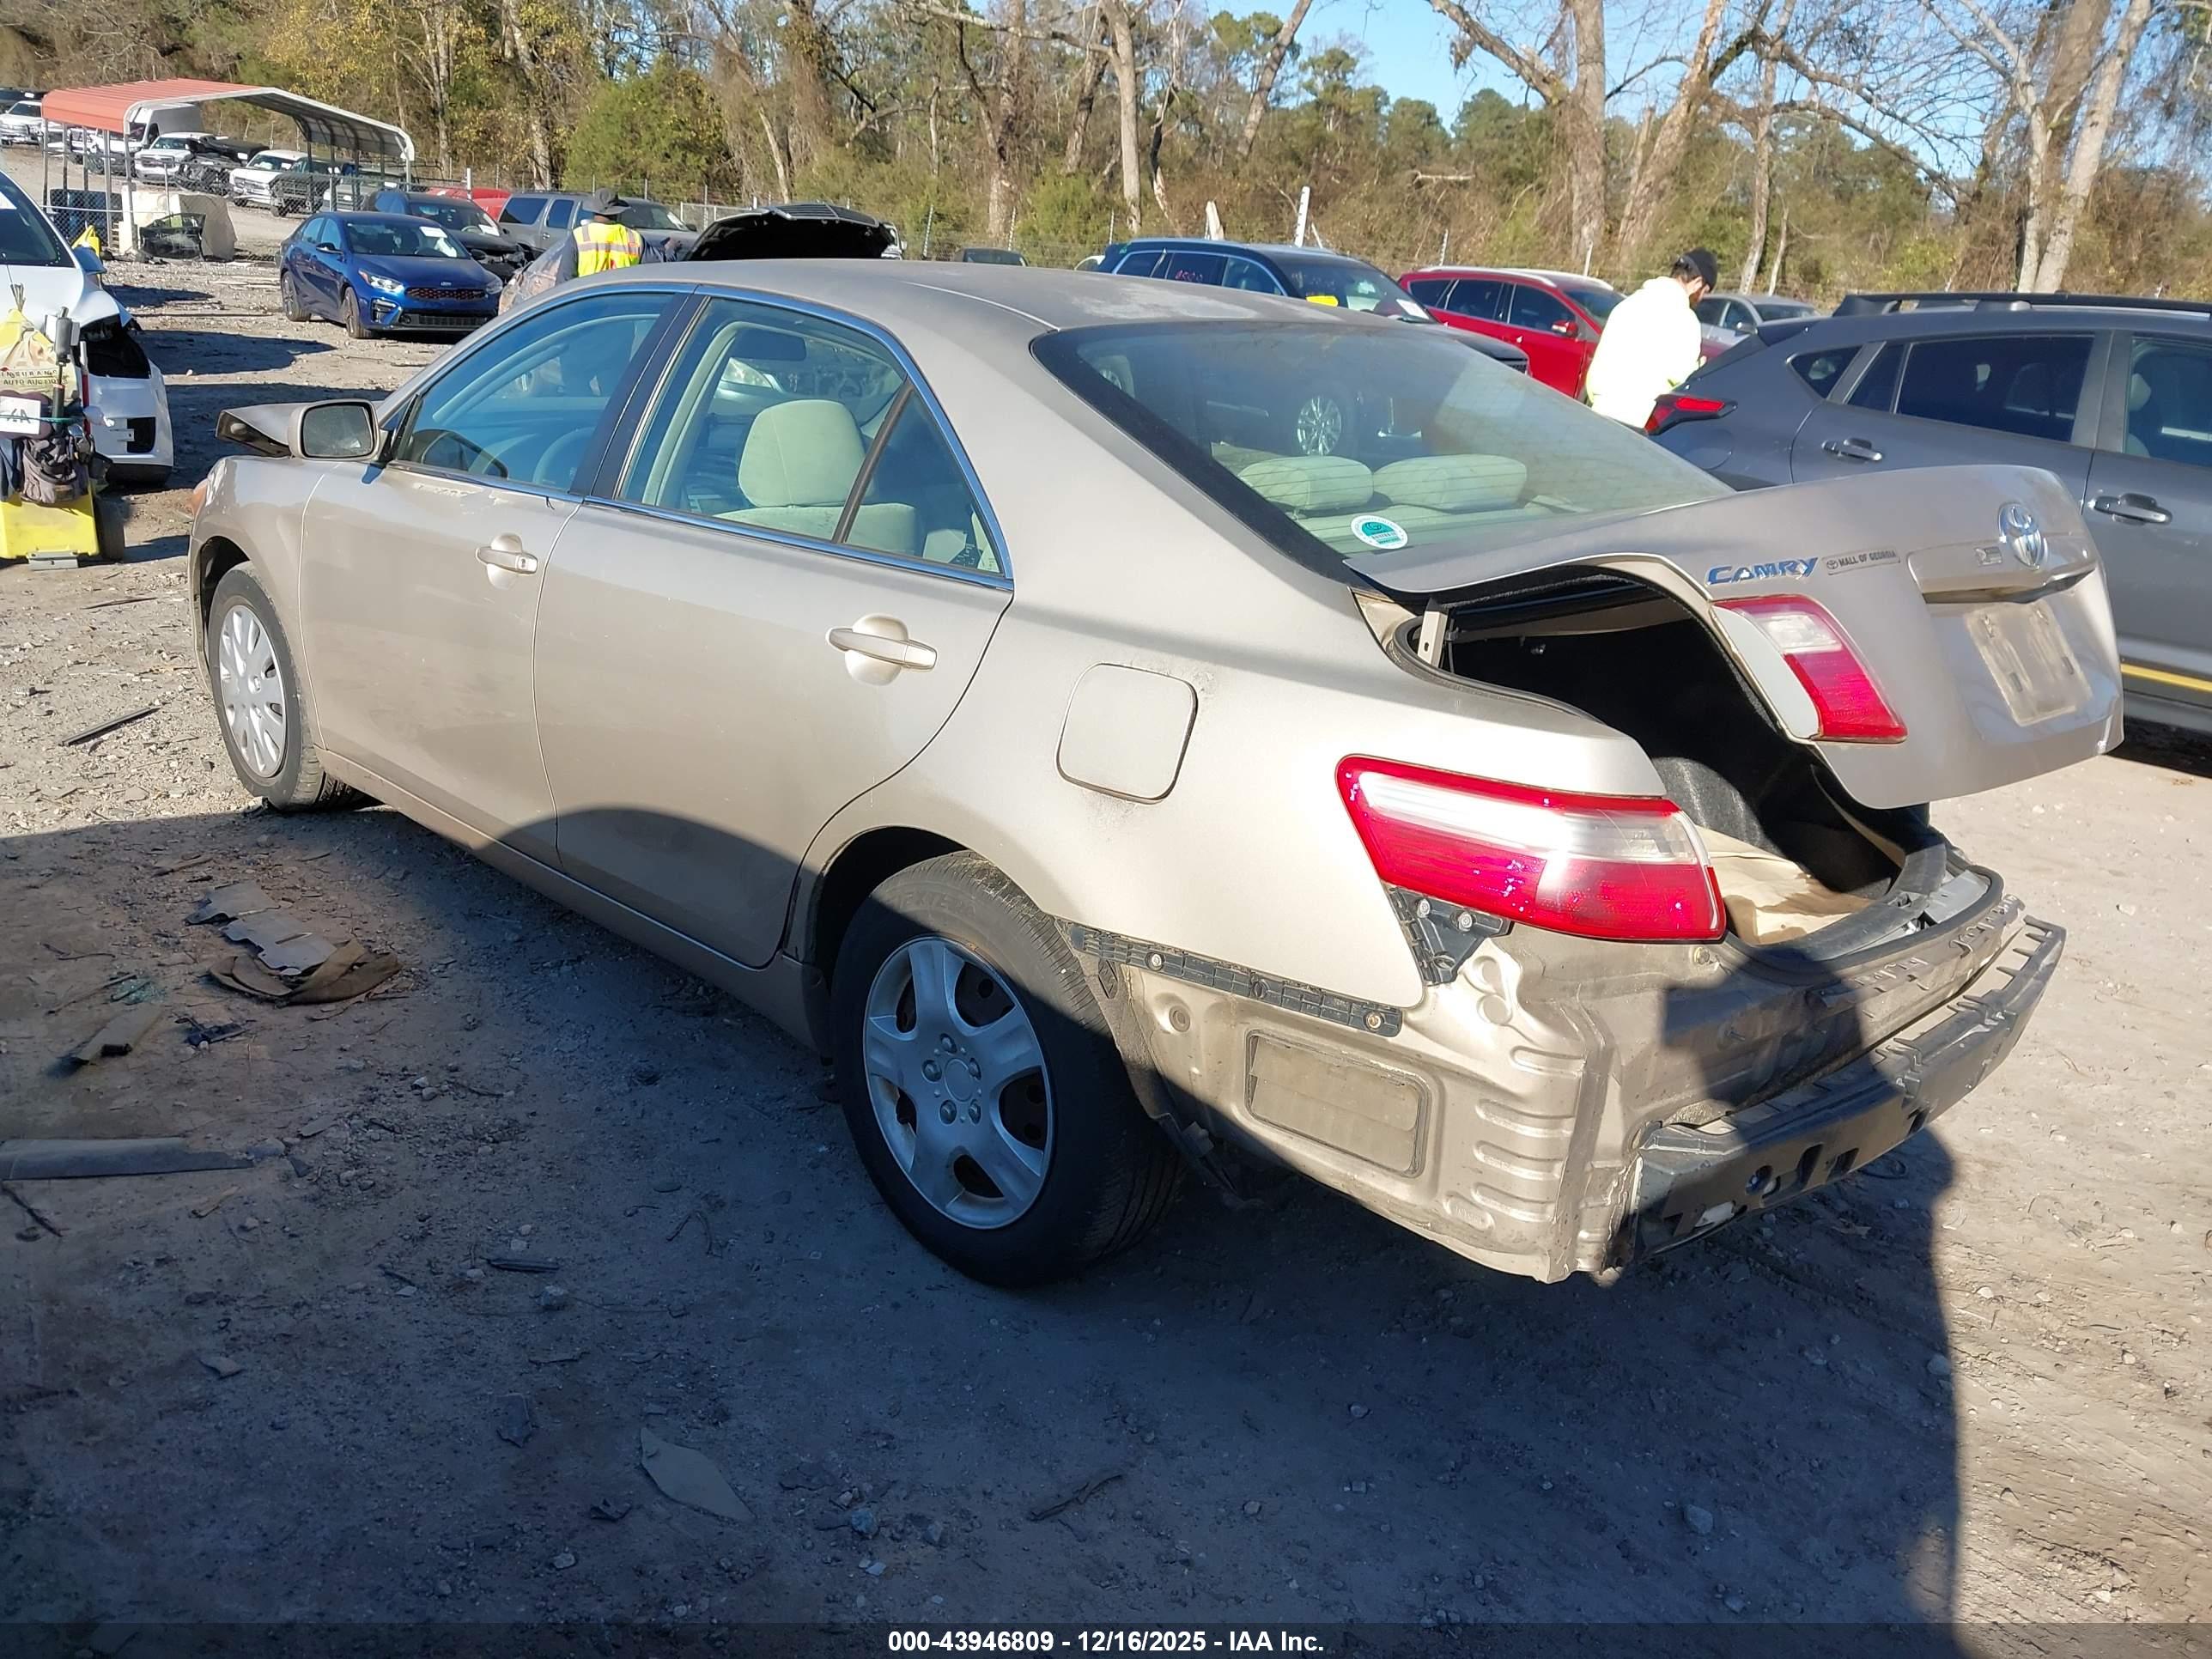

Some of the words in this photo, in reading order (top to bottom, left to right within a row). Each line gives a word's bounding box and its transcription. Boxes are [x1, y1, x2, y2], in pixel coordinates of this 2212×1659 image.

[1706, 556, 1819, 585] CAMRY
[1838, 556, 1859, 567] MALL
[1858, 553, 1868, 562] OF
